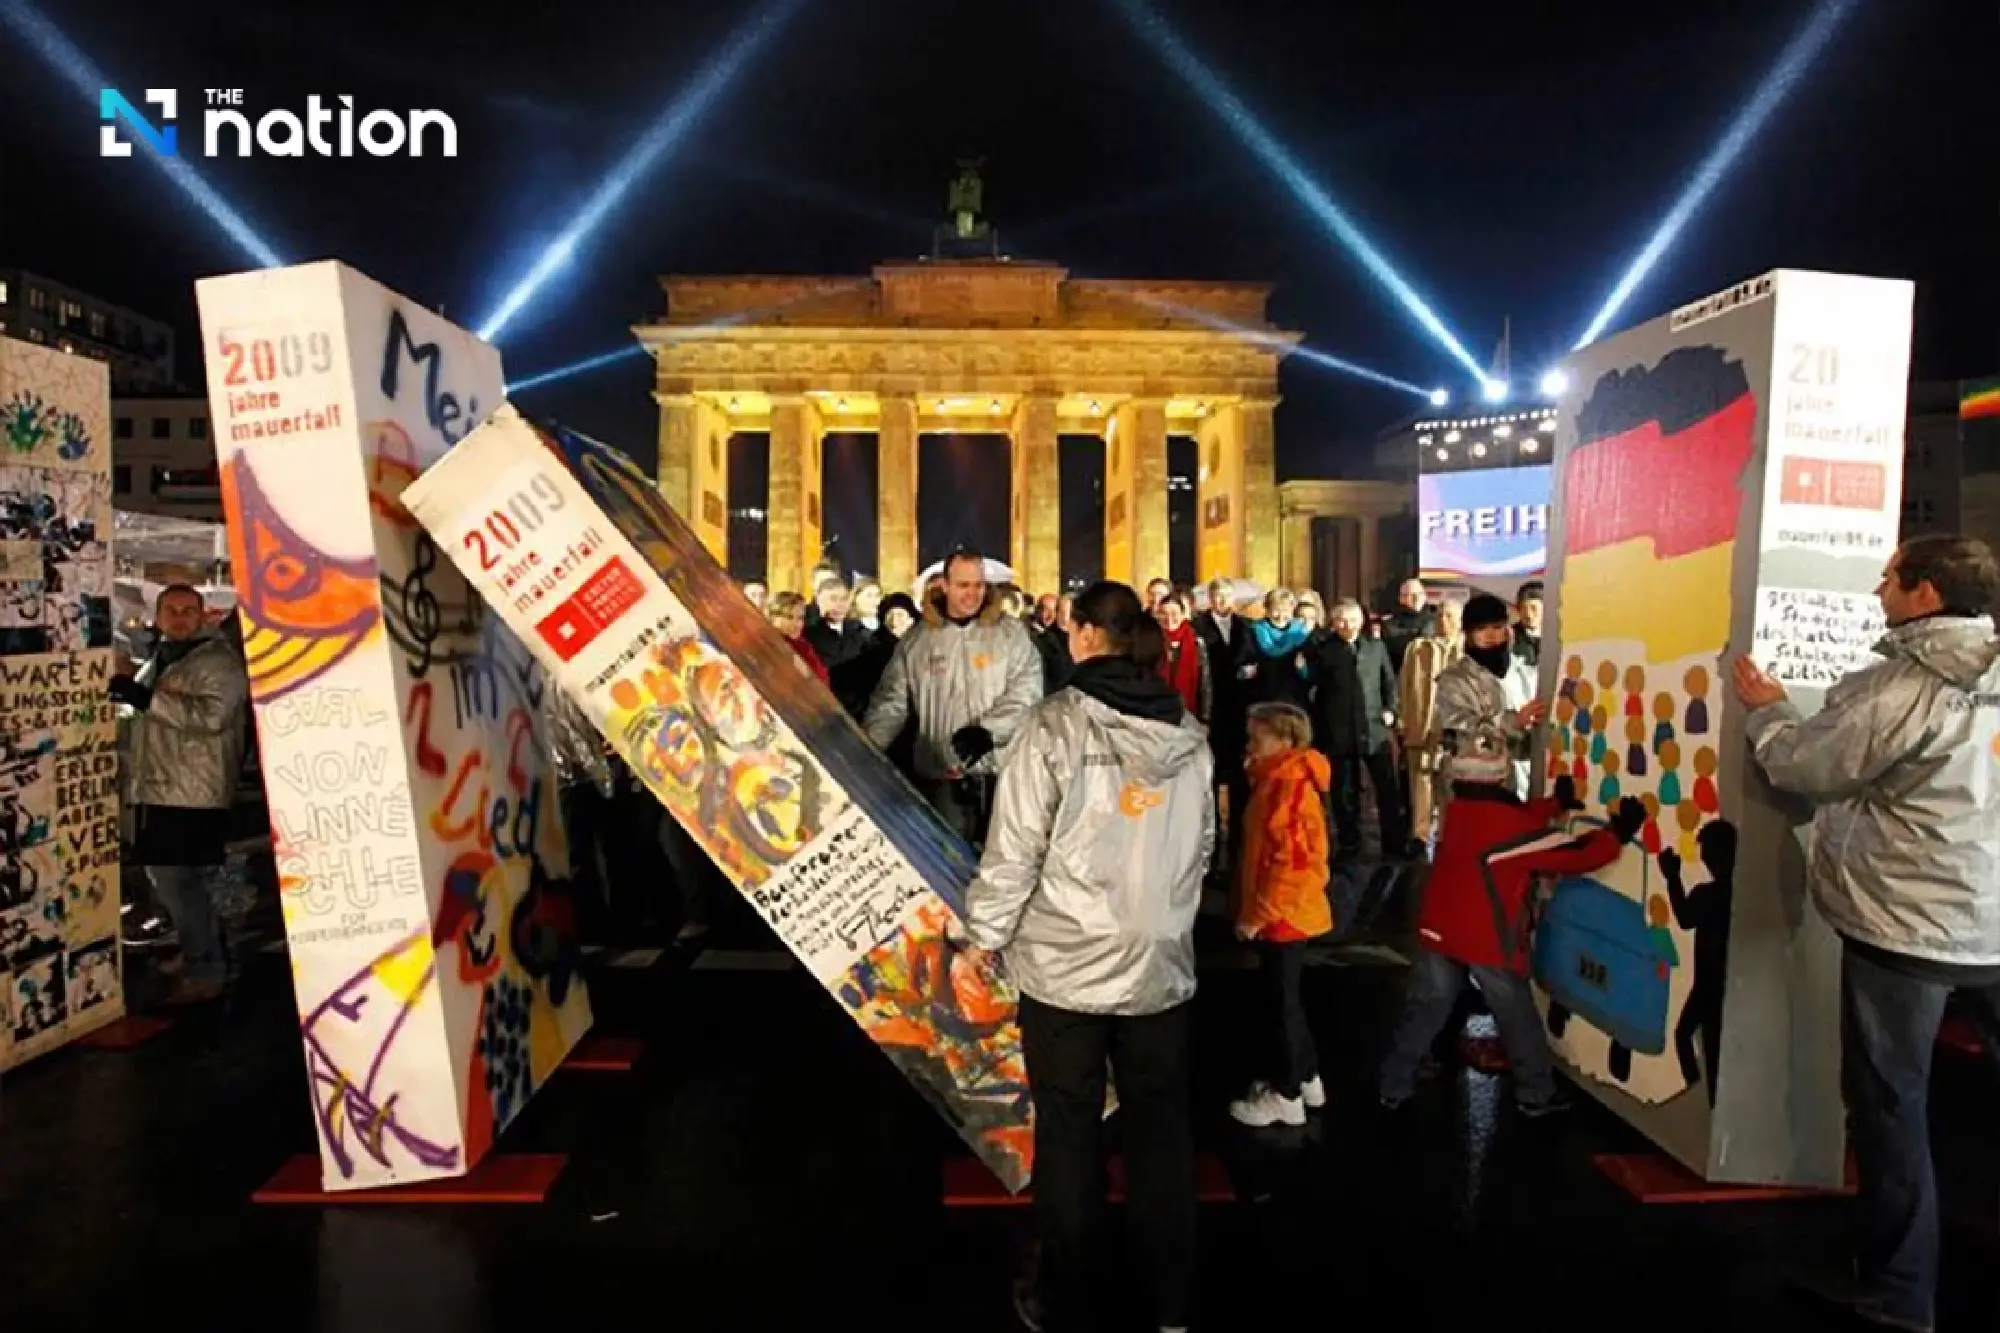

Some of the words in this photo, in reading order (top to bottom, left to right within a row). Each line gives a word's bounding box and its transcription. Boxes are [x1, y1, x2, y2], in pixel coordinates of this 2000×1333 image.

[219, 332, 333, 386] 2009
[228, 391, 280, 418] jahre
[231, 404, 341, 441] mauerfall
[464, 471, 567, 571] 2009
[1421, 504, 1546, 537] FREIH
[495, 550, 541, 597] jahre
[513, 527, 604, 613] mauerfall
[274, 741, 388, 796] VON
